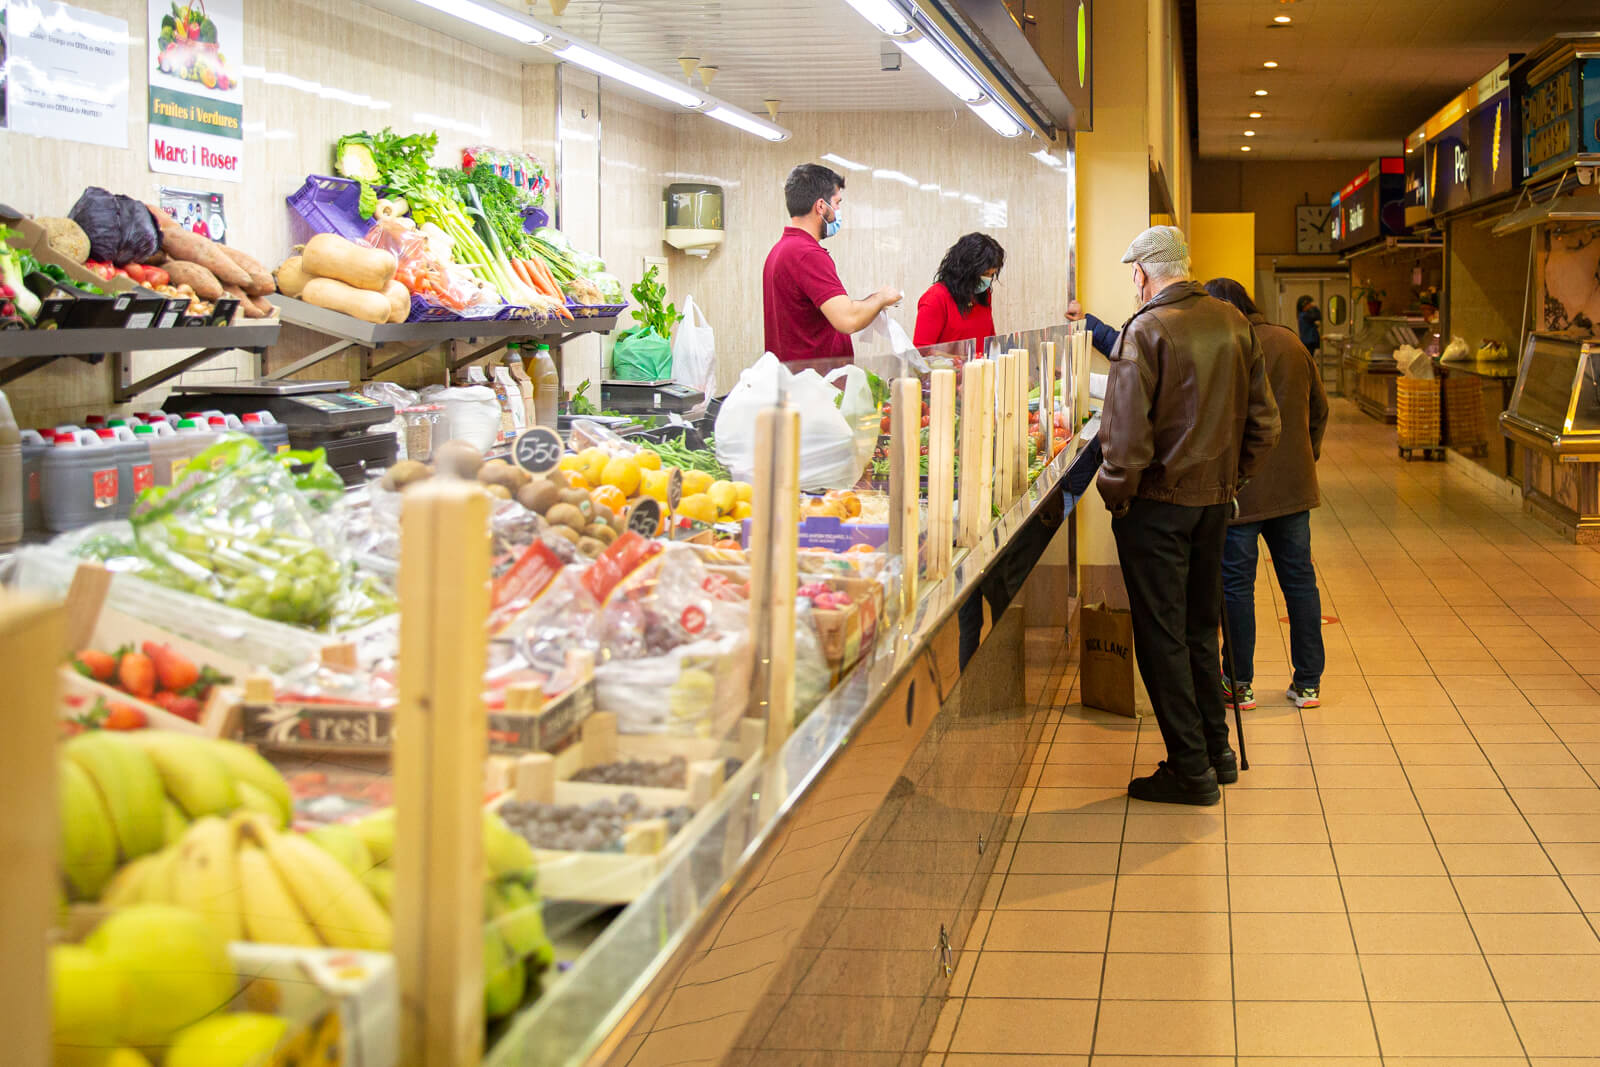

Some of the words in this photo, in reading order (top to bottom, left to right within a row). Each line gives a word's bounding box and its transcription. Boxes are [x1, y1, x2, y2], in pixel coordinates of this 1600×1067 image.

[153, 98, 188, 120] Fruites
[190, 105, 195, 120] i
[196, 107, 238, 128] Verdures
[154, 138, 188, 164] Marc
[192, 145, 196, 165] i
[201, 146, 239, 171] Roser
[1104, 639, 1128, 659] LANE
